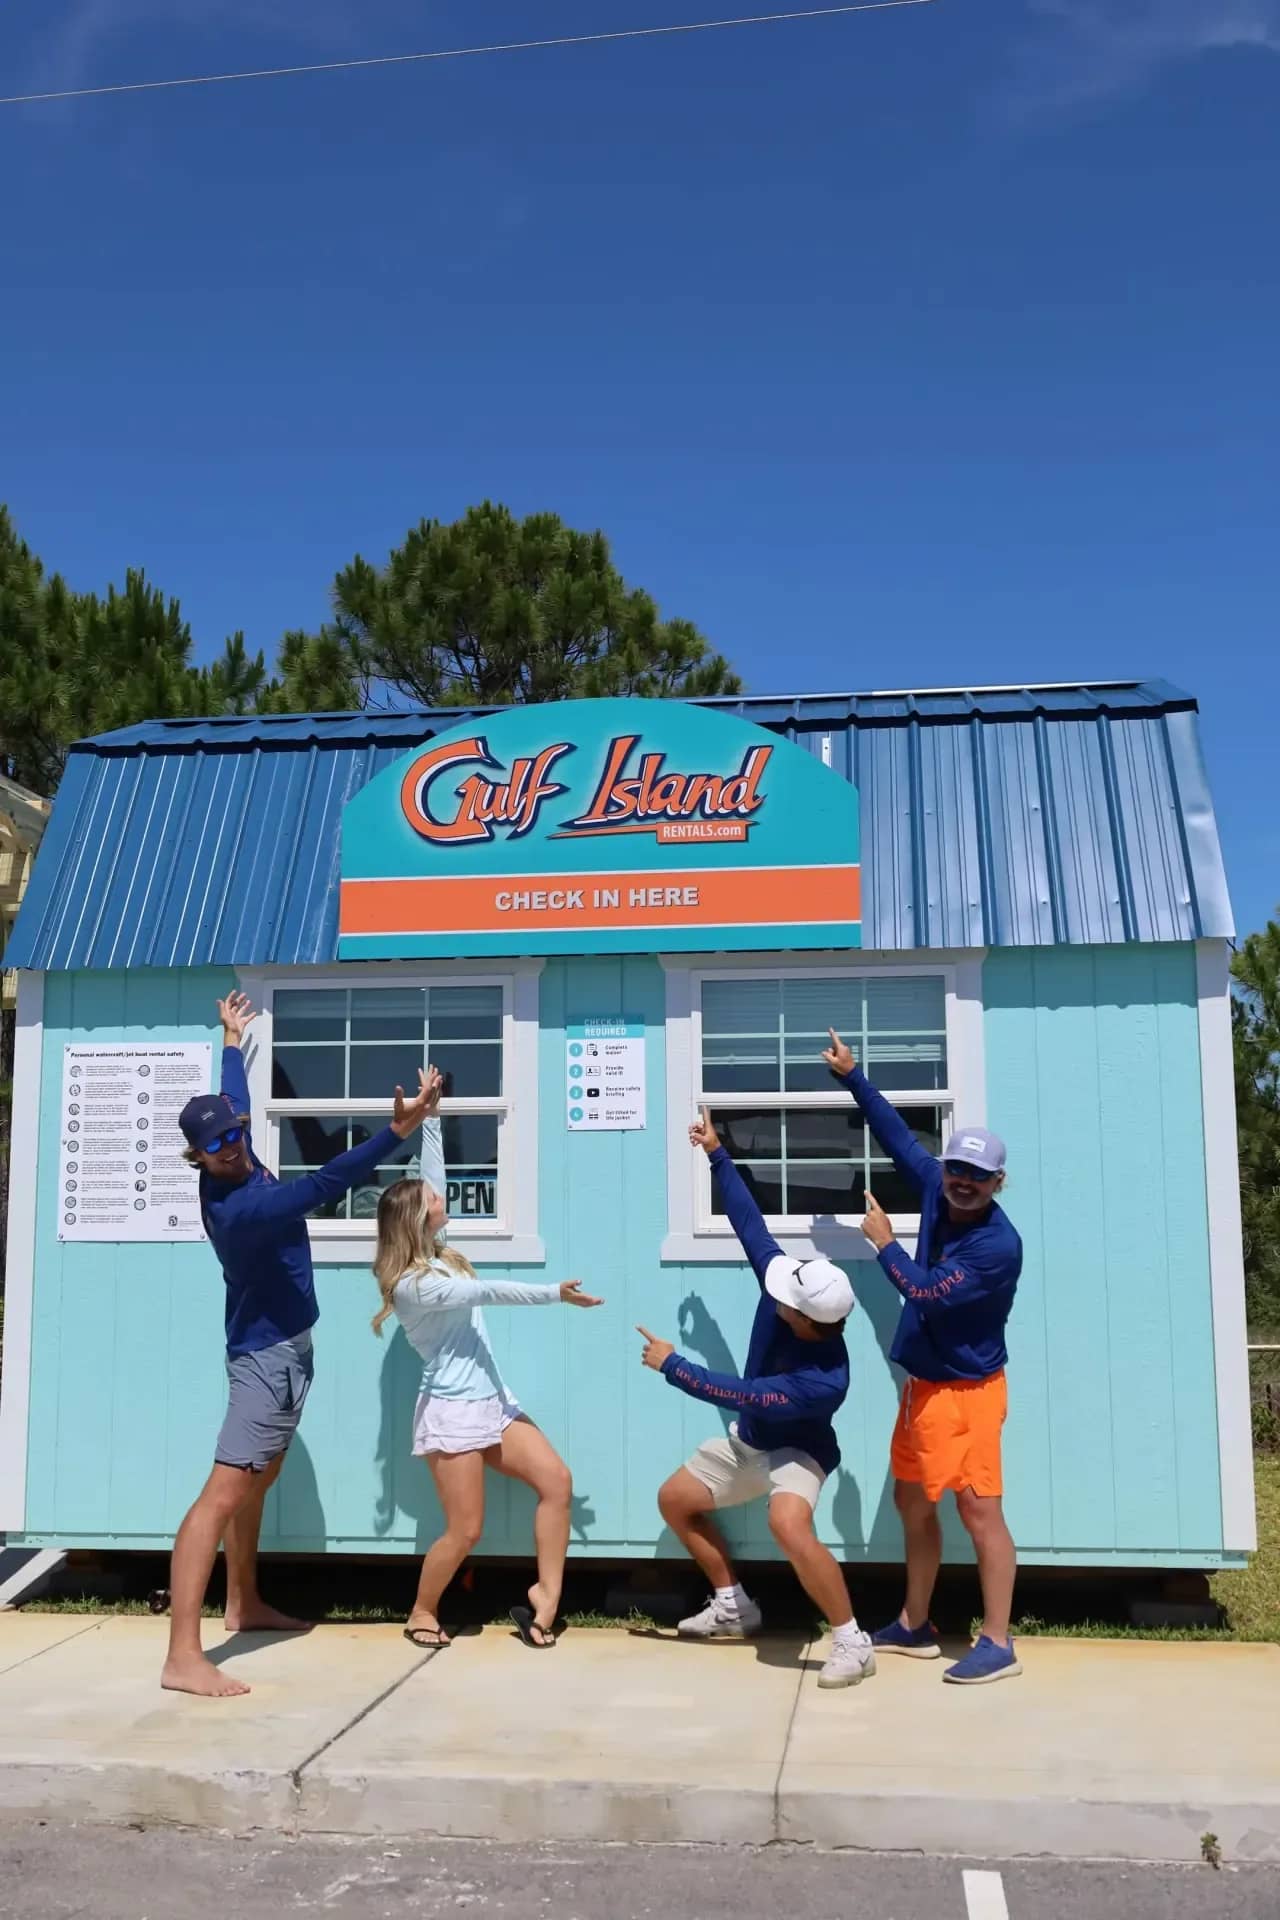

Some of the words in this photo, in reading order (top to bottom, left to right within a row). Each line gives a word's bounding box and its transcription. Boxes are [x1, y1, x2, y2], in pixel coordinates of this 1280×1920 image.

[400, 735, 577, 846] Gulf
[557, 734, 773, 828] Island
[662, 824, 742, 839] RENTALS.com
[495, 890, 585, 912] CHECK
[593, 889, 620, 909] IN
[629, 887, 699, 908] HERE
[584, 1027, 627, 1036] REQUIRED
[446, 1181, 495, 1214] PEN
